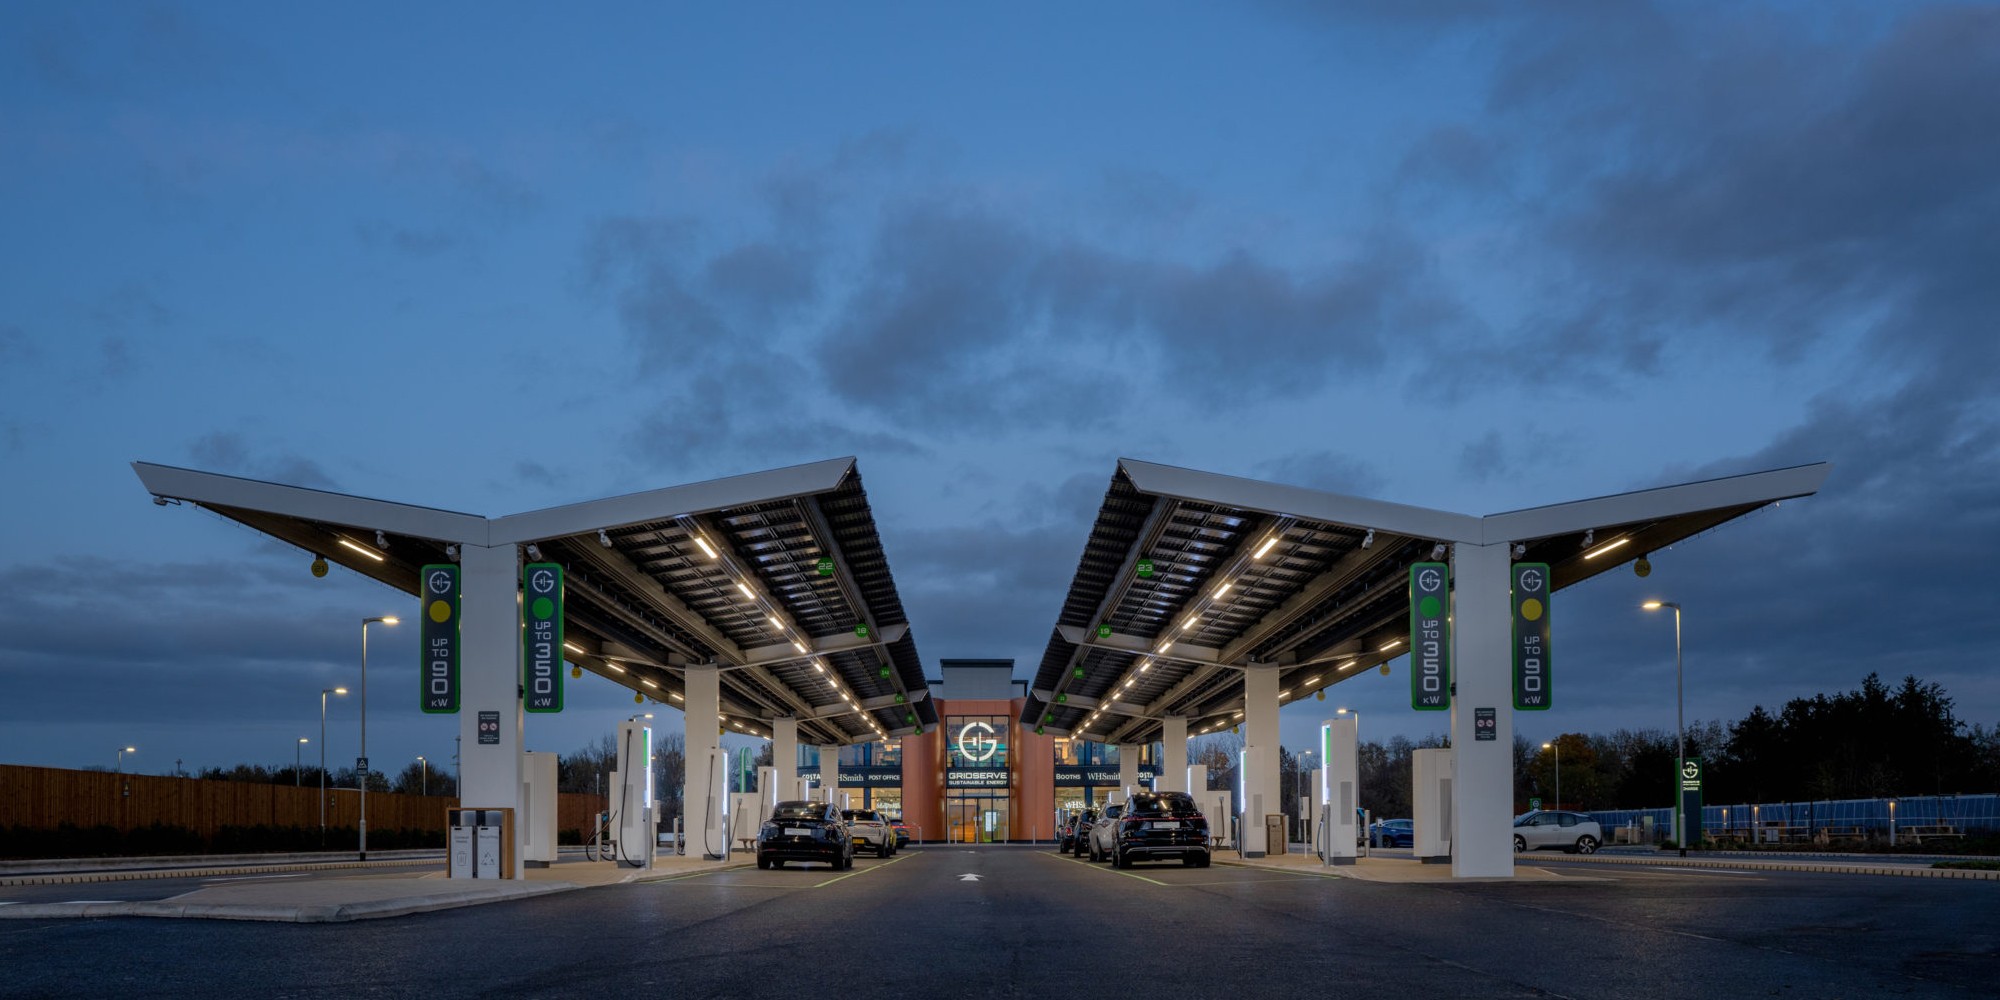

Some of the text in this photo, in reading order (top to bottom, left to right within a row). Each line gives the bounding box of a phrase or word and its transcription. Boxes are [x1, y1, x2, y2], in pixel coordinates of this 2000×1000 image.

[818, 562, 833, 570] 22
[1138, 564, 1153, 572] 23
[1422, 620, 1438, 628] UP
[535, 632, 551, 640] TO
[1524, 636, 1540, 644] UP
[432, 639, 448, 647] UP
[432, 649, 448, 657] TO
[1524, 647, 1540, 655] TO
[837, 773, 864, 782] HSmith
[948, 772, 1008, 780] GRIDSERVE
